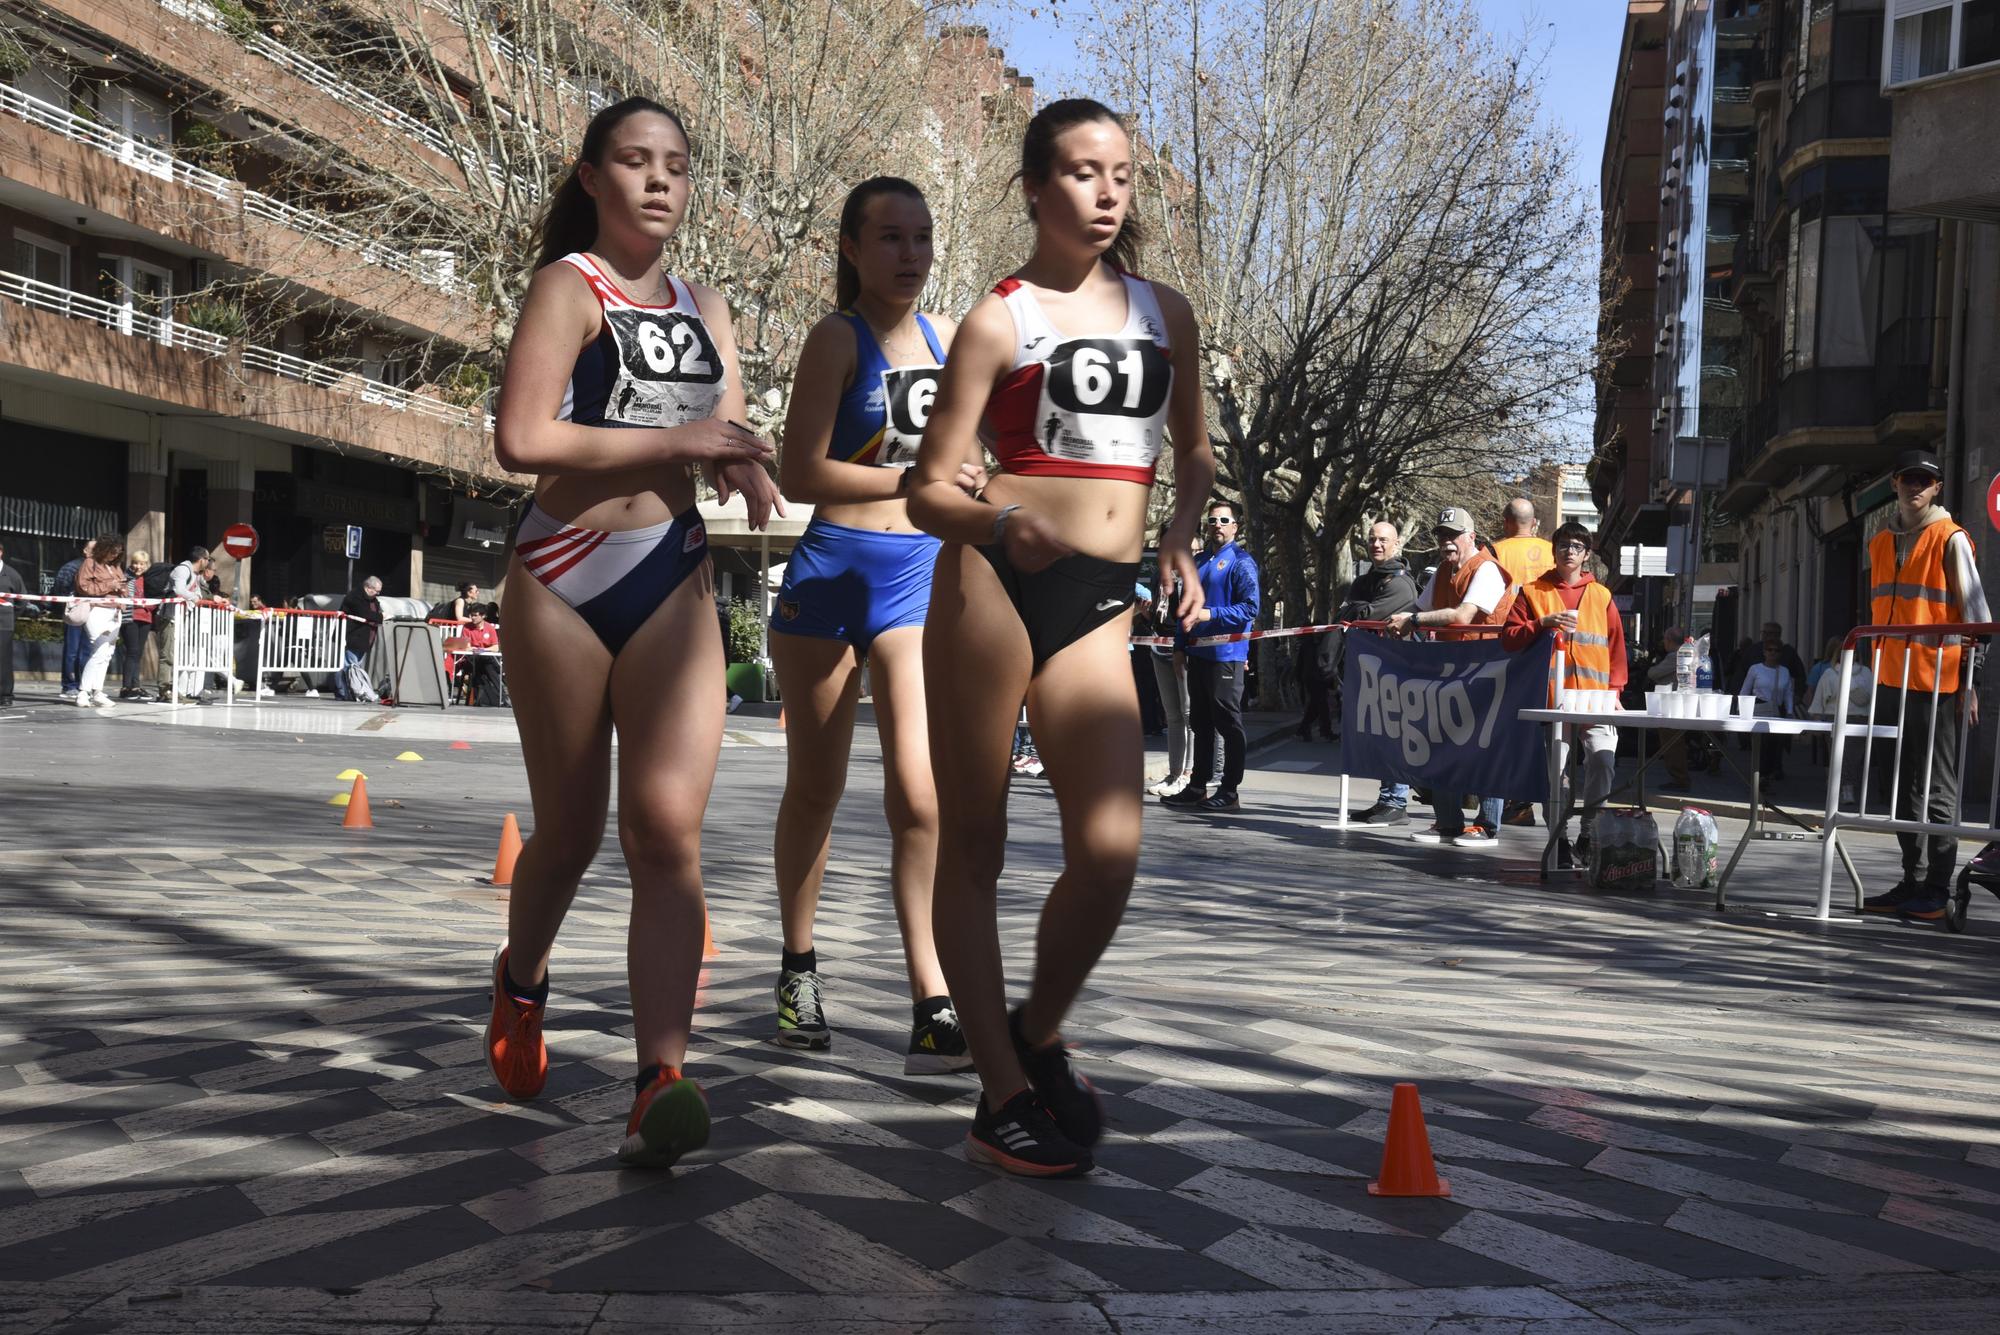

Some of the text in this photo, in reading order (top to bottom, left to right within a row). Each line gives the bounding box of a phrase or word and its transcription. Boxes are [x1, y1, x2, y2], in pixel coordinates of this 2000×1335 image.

[638, 321, 712, 376] 62
[908, 378, 939, 429] 6
[1071, 347, 1144, 409] 61
